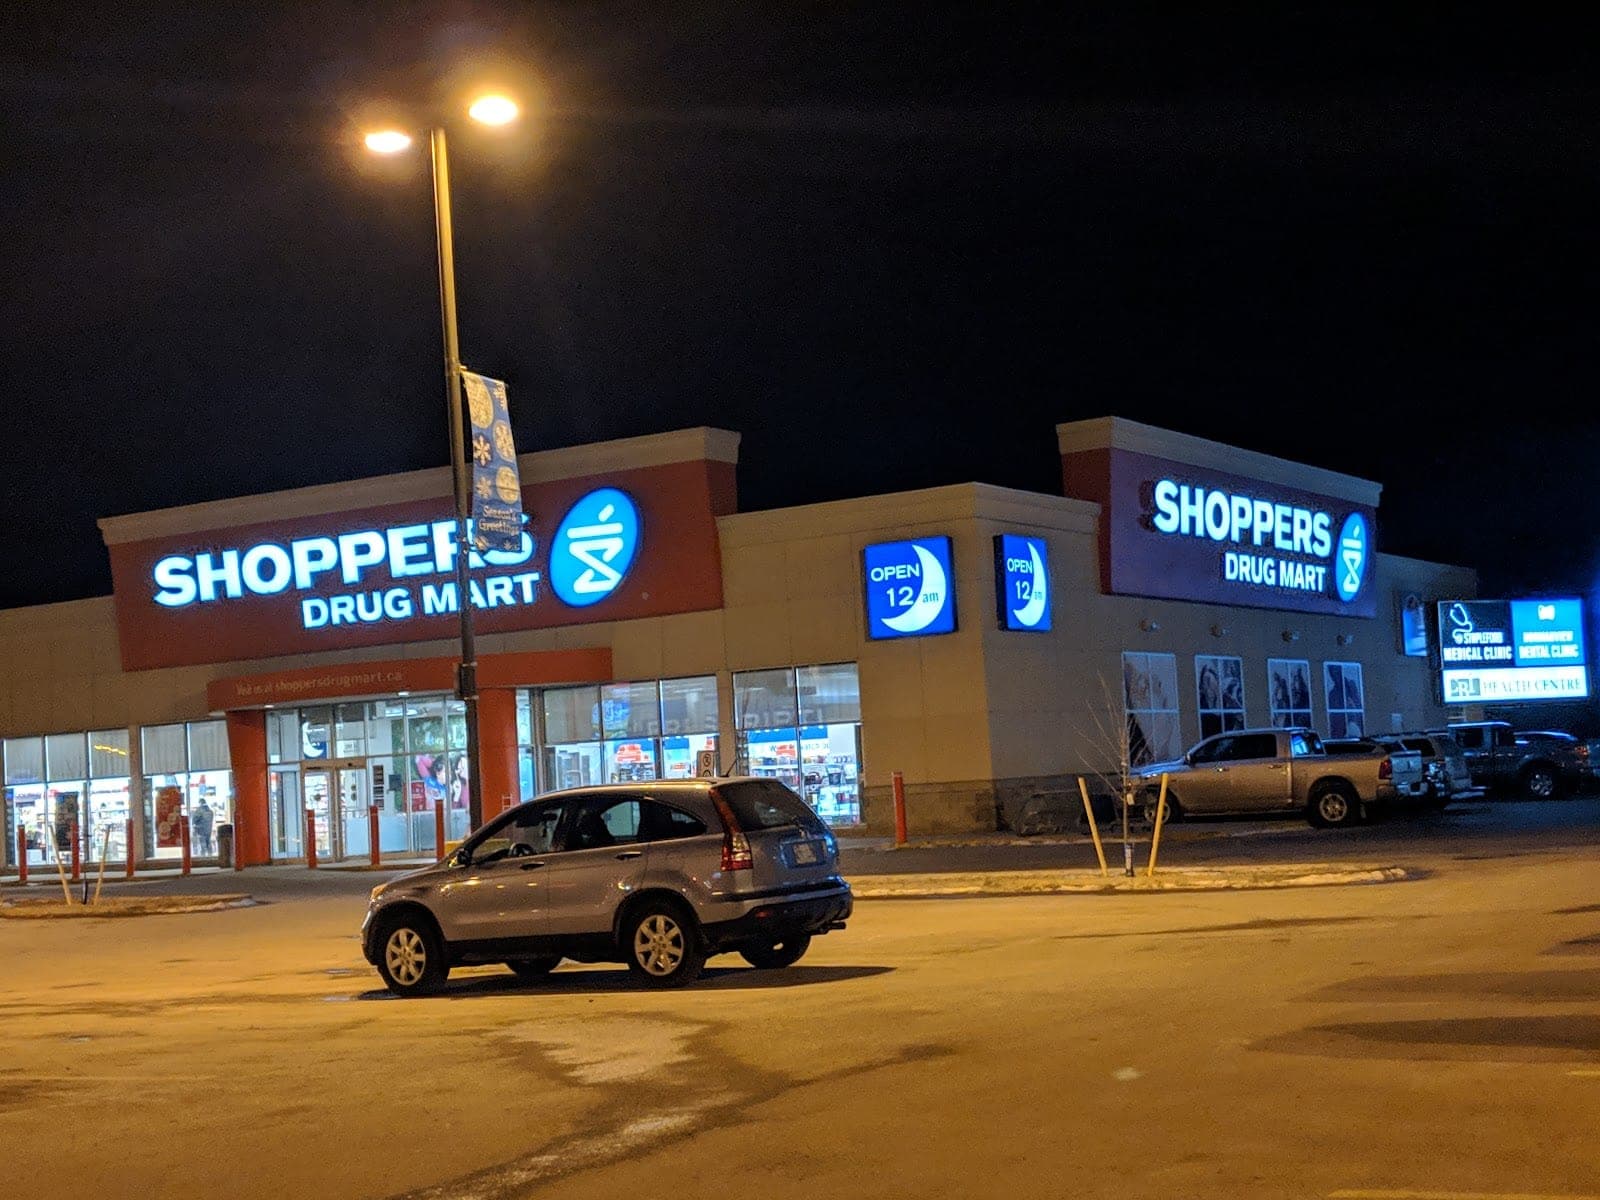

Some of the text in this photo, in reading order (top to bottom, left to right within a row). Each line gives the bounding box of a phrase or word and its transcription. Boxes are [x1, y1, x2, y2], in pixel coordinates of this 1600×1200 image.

[479, 519, 519, 536] Greetings
[1153, 479, 1332, 558] SHOPPERS
[870, 563, 921, 582] OPEN
[1005, 557, 1033, 574] OPEN
[1224, 551, 1326, 592] DRUG MART
[886, 586, 940, 608] 12 am
[1013, 579, 1031, 600] 12
[301, 572, 541, 629] DRUG MART
[1443, 646, 1512, 661] MEDICAL CLINIC
[1534, 677, 1580, 692] CENTRE
